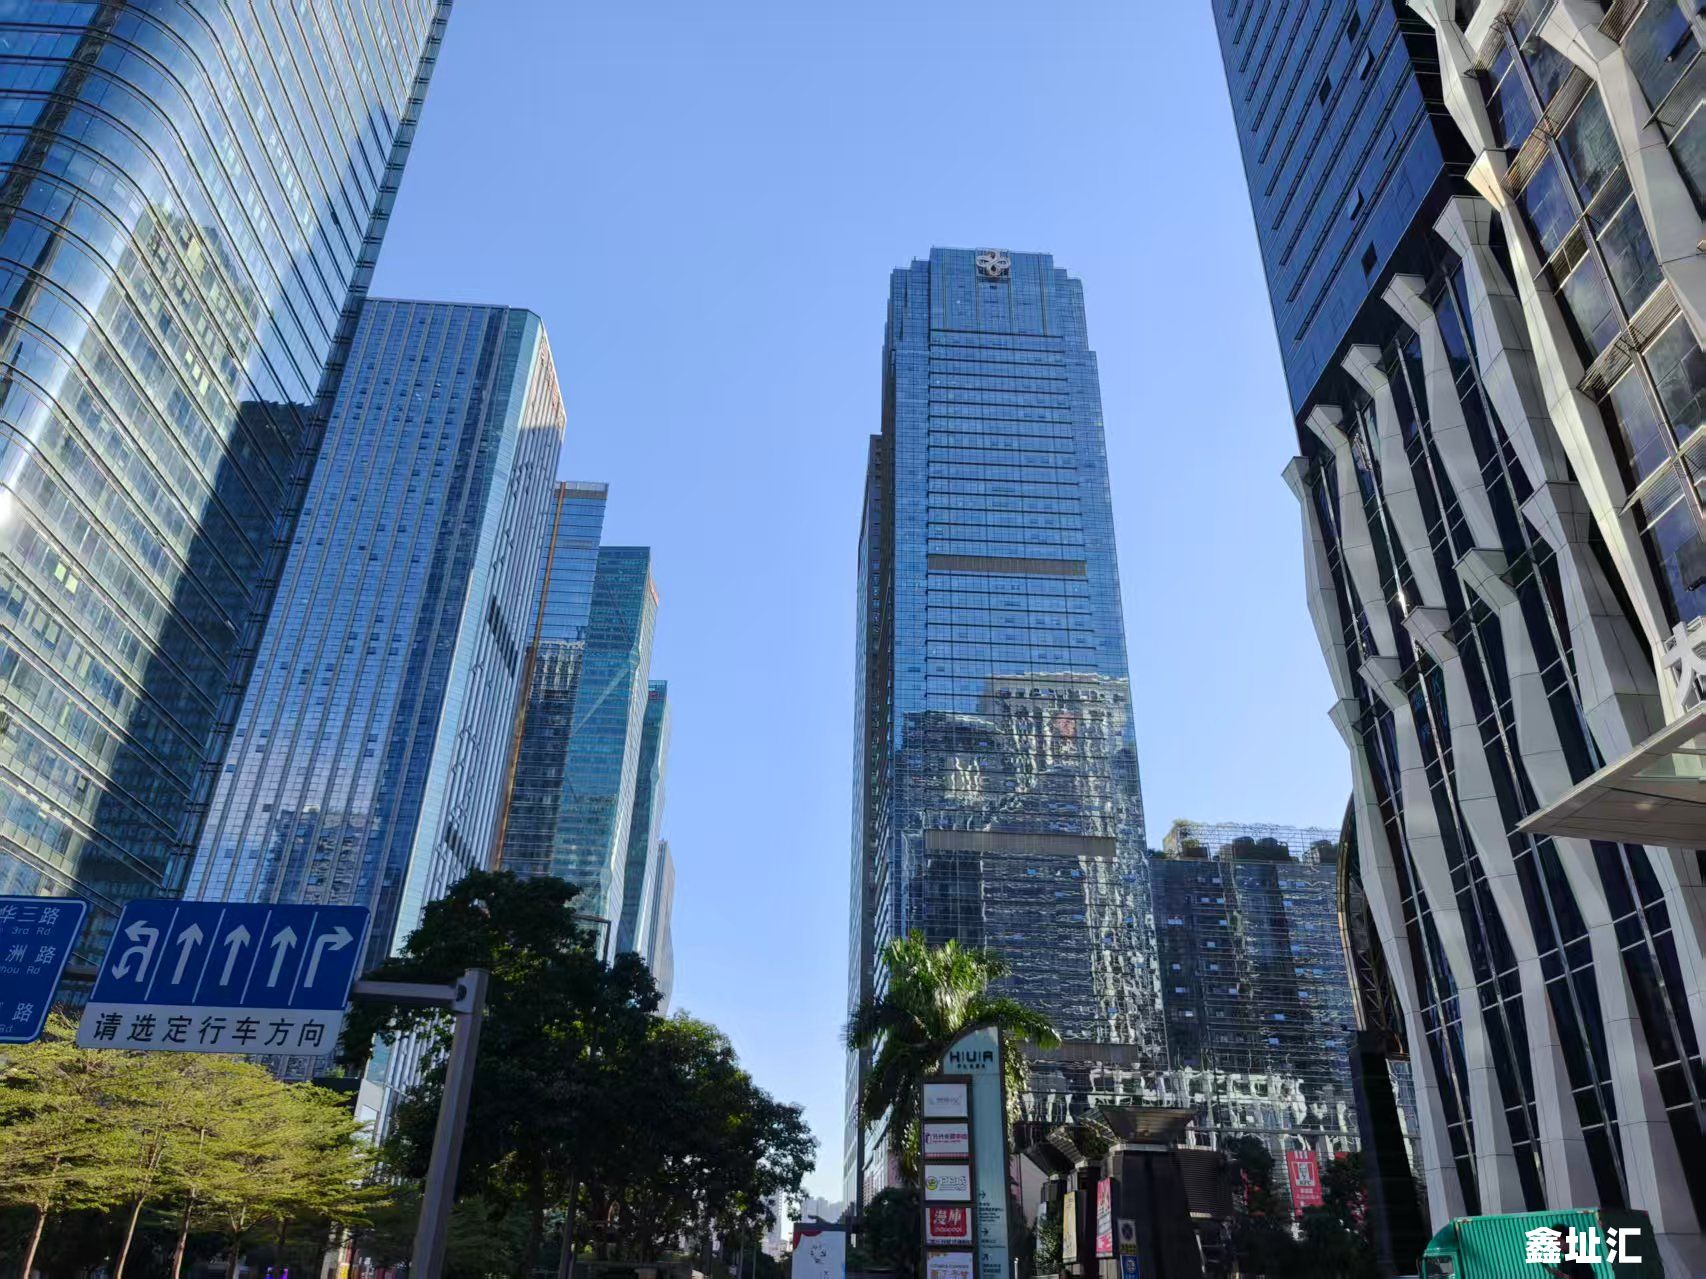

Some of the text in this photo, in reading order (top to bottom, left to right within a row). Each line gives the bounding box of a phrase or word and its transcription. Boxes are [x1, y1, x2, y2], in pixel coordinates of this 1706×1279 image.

[36, 926, 52, 936] Rd
[26, 965, 42, 975] Rd
[92, 1012, 327, 1047] 请选定行车方向
